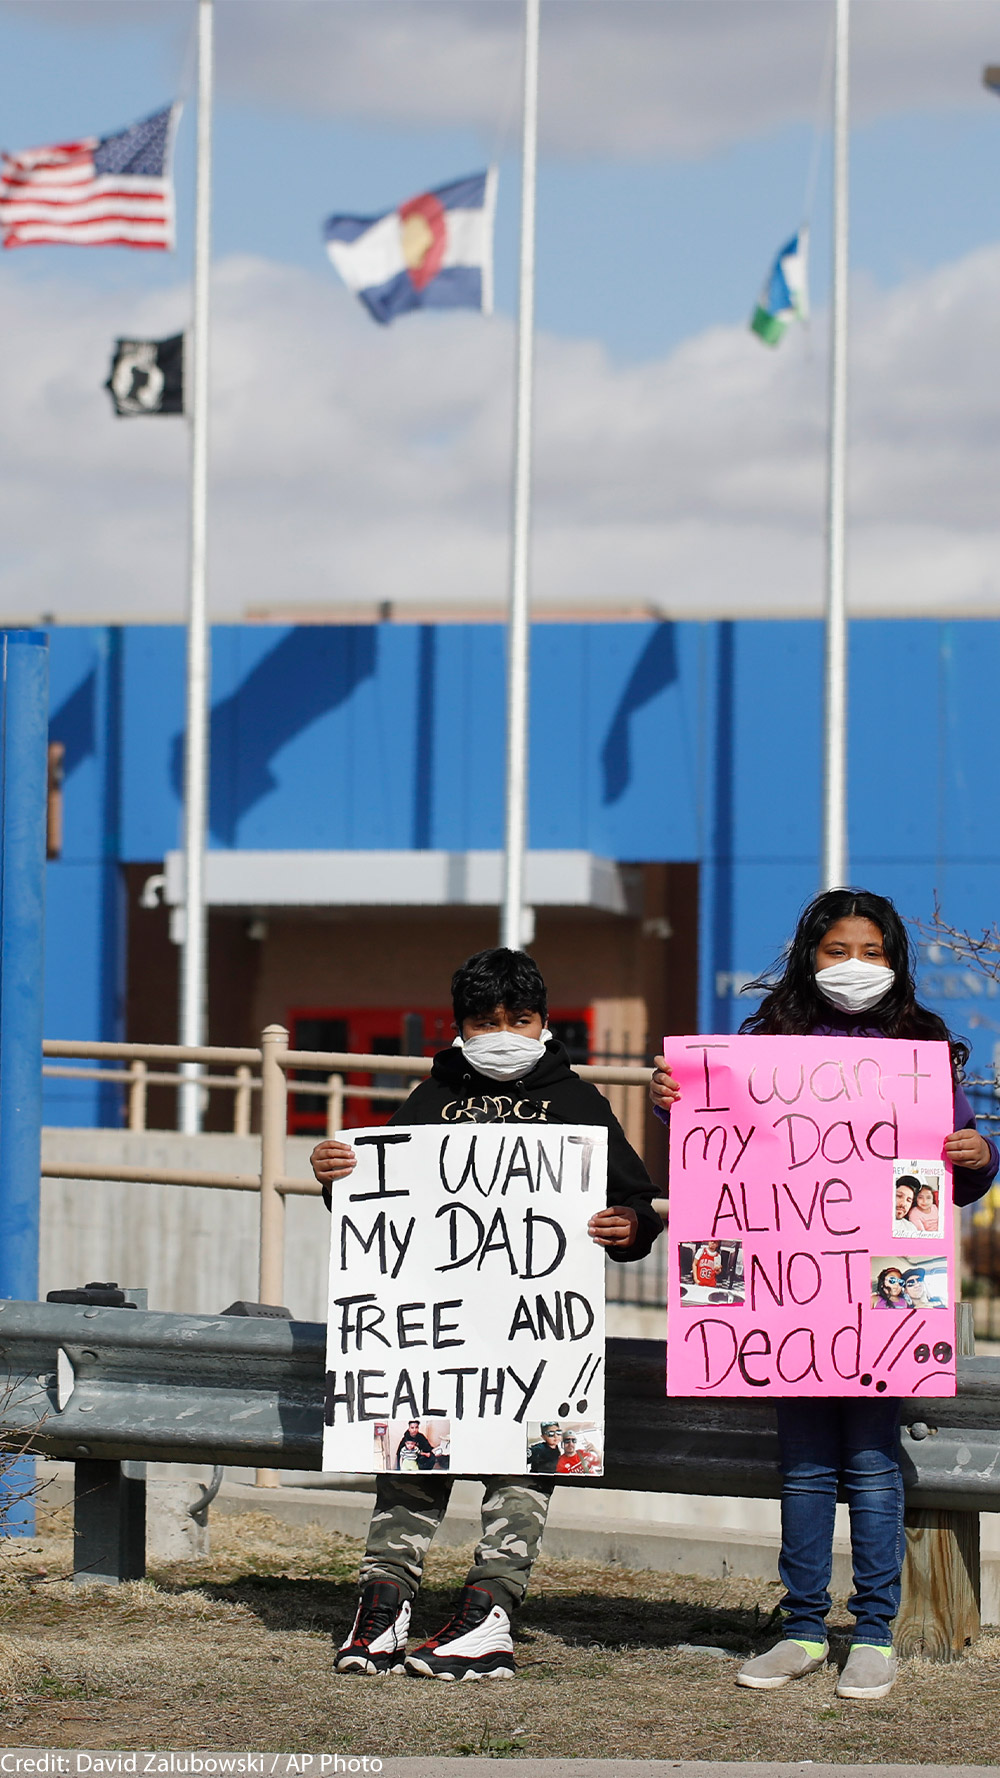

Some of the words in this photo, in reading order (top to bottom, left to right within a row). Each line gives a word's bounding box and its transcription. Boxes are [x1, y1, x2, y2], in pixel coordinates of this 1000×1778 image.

[686, 1045, 730, 1112] I
[748, 1049, 931, 1104] want
[350, 1133, 412, 1201] I
[439, 1134, 607, 1197] WANT
[683, 1126, 755, 1173] my
[773, 1102, 898, 1170] Dad
[340, 1211, 415, 1279] MY
[435, 1202, 566, 1279] DAD
[751, 1249, 868, 1311] NOT
[334, 1294, 465, 1354] FREE
[508, 1291, 594, 1341] AND
[325, 1359, 547, 1426] HEALTHY
